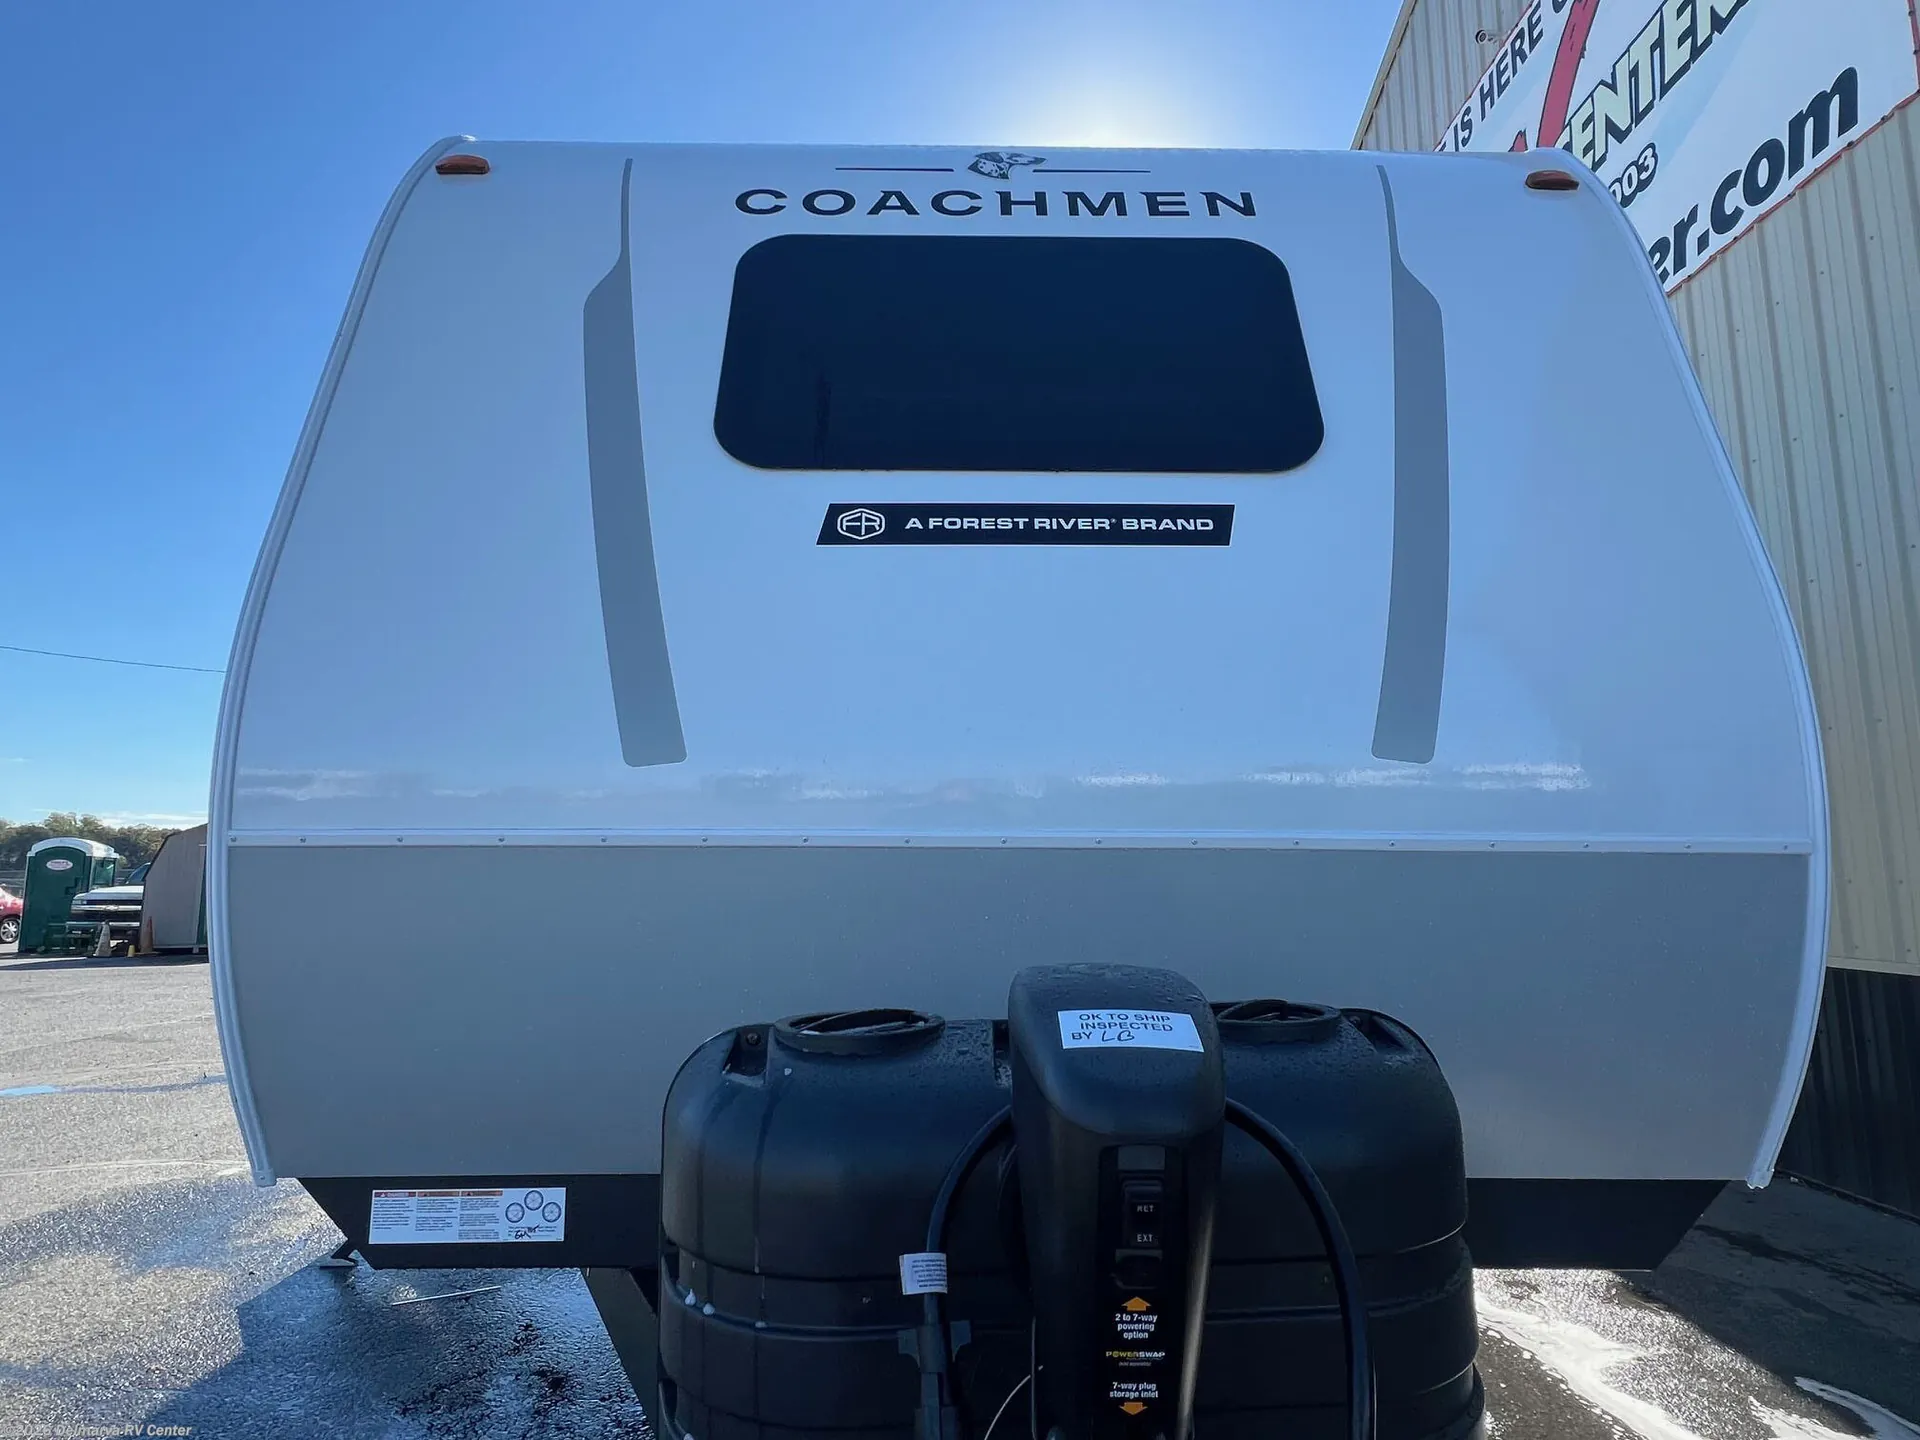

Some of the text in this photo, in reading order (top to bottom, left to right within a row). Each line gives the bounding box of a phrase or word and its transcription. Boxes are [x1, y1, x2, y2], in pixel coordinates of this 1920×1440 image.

[1454, 0, 1543, 152] IS HERE
[735, 188, 1257, 216] COACHMEN
[904, 518, 924, 530] A
[928, 517, 1029, 530] FOREST
[1122, 517, 1214, 531] BRAND
[1079, 1013, 1171, 1023] OK TO SHIP
[1080, 1022, 1173, 1032] INSPECTED
[1071, 1032, 1092, 1040] BY
[1137, 1233, 1153, 1243] EXT
[1115, 1313, 1158, 1323] 2 to 7-way
[1117, 1323, 1155, 1332] powering
[1123, 1331, 1149, 1340] option
[1112, 1381, 1157, 1391] 7-way plug
[1109, 1391, 1139, 1399] storage
